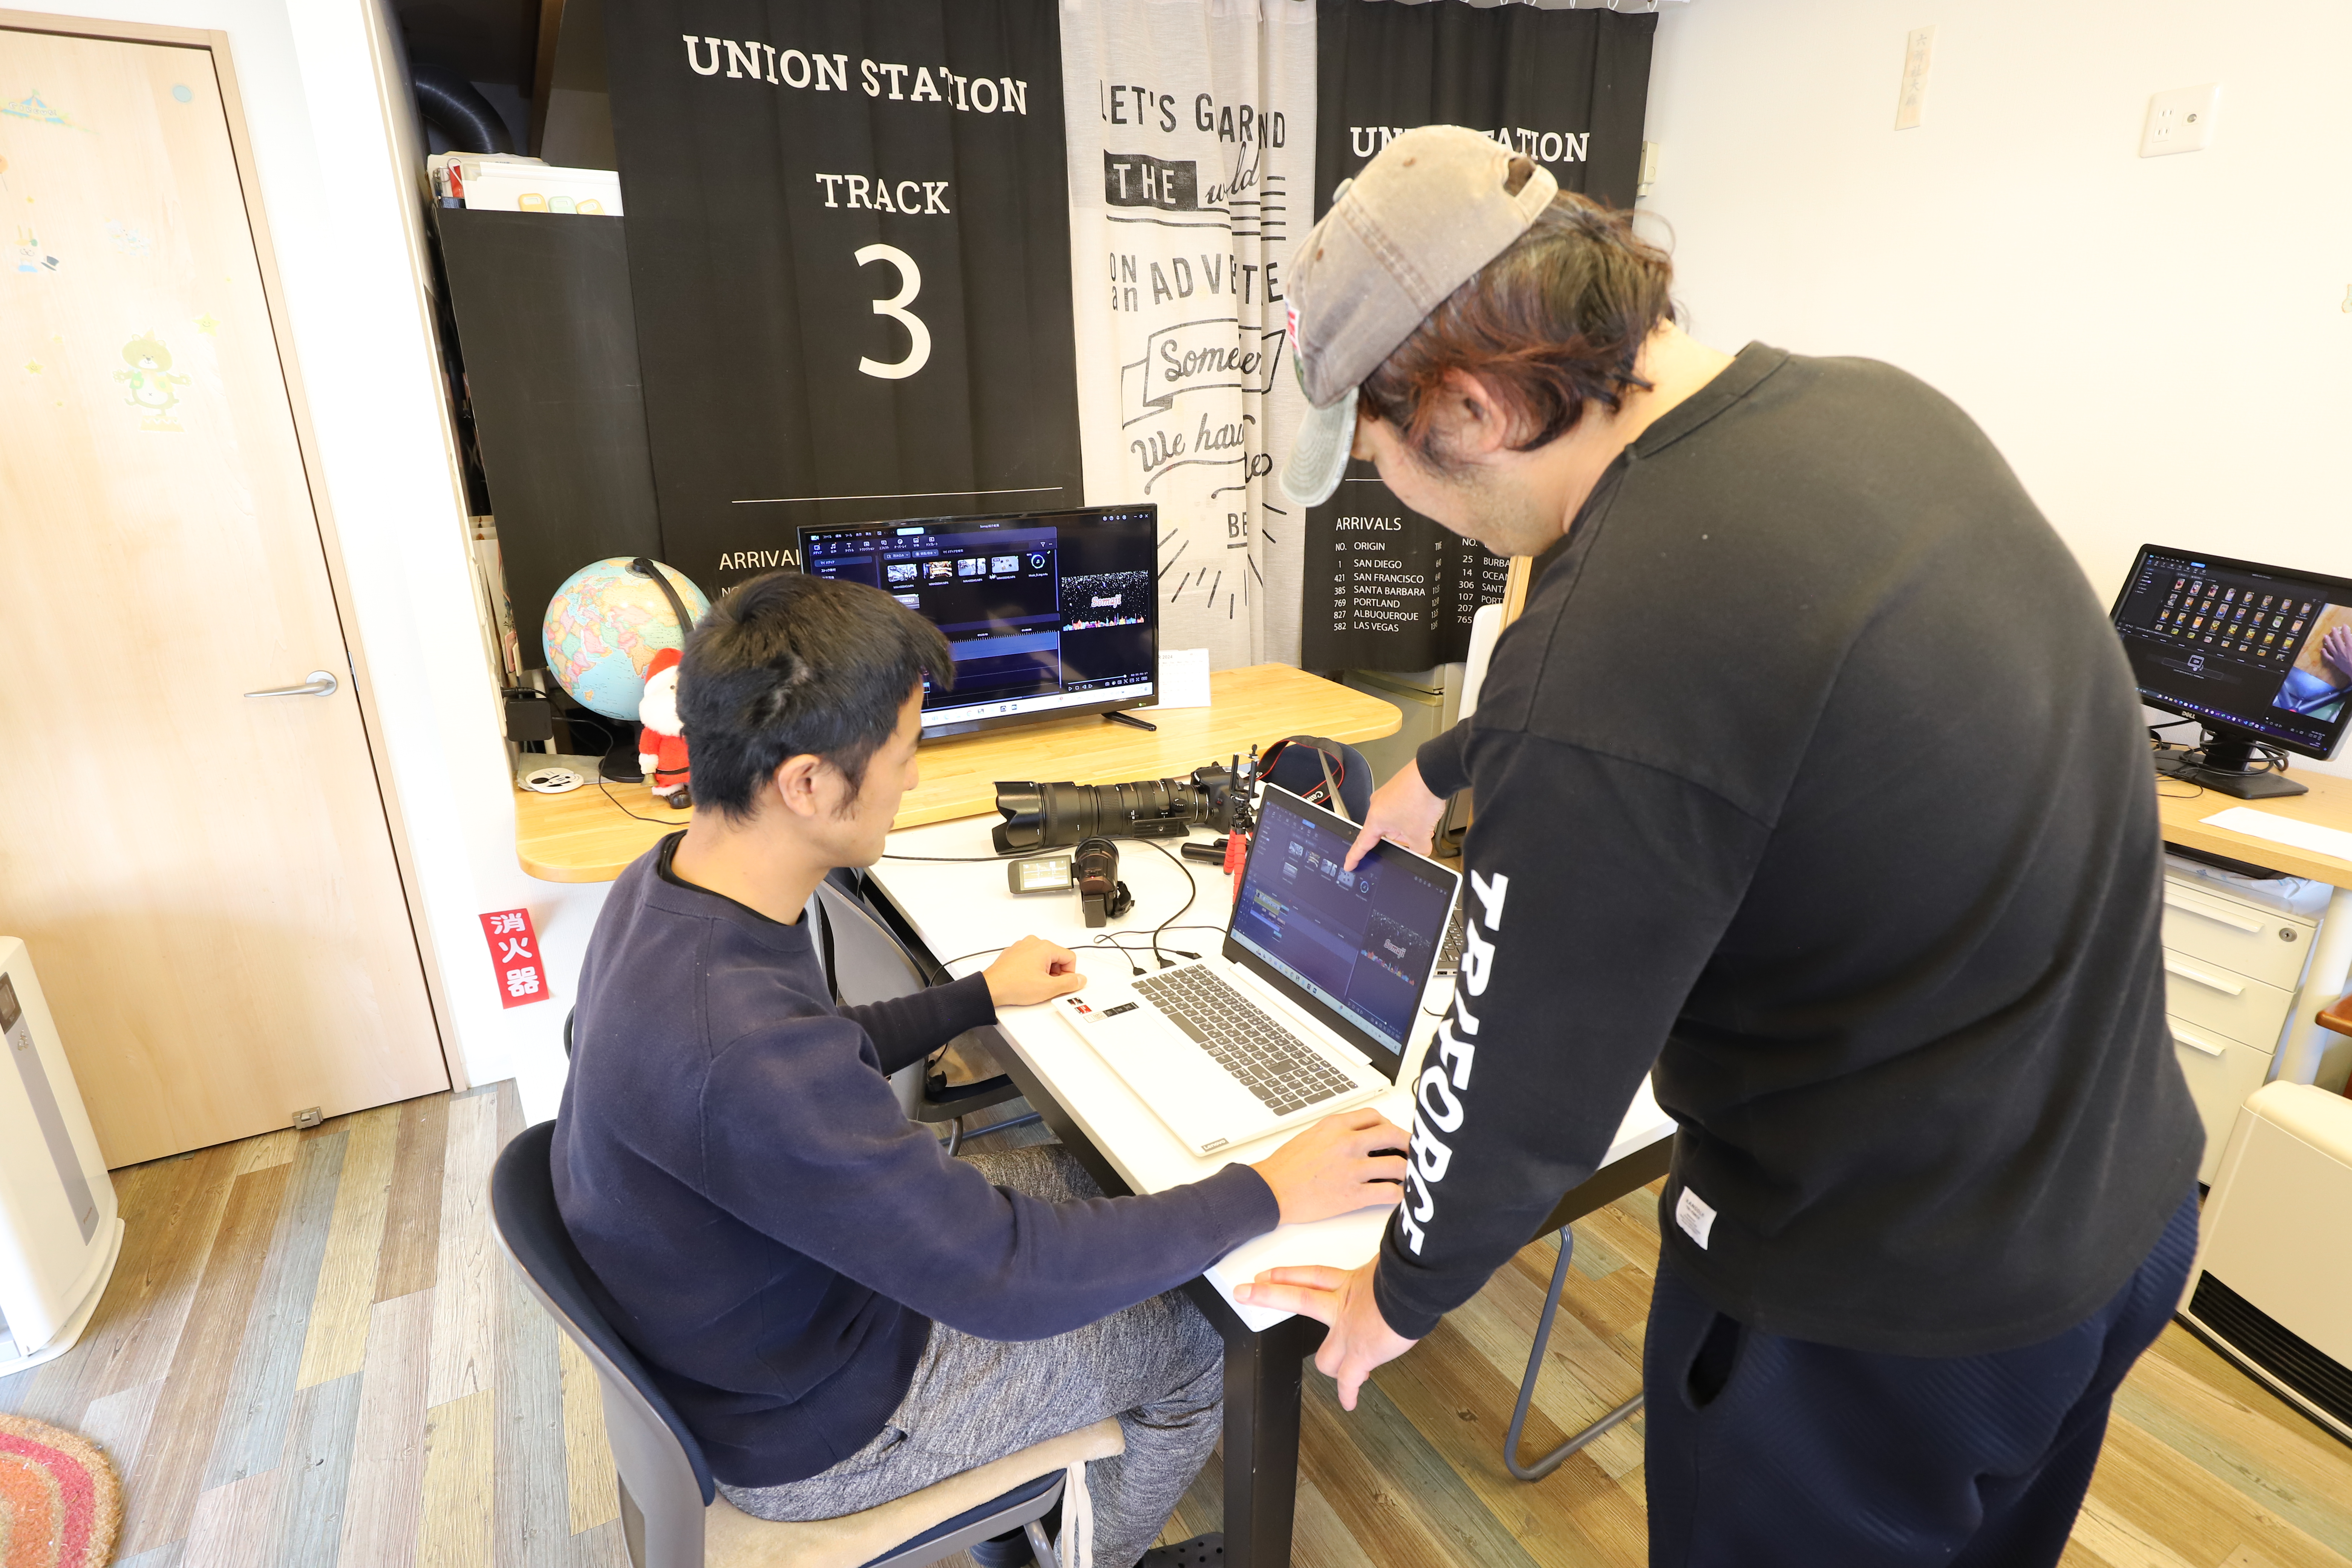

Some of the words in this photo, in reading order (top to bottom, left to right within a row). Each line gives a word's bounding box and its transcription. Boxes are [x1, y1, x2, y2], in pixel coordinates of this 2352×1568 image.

[683, 34, 848, 91] UNION
[861, 59, 1027, 115] STATION
[1113, 164, 1177, 204] THE
[816, 173, 950, 214] TRACK
[1110, 252, 1136, 283] ON
[1112, 286, 1138, 312] an
[854, 244, 931, 379] 3
[1130, 430, 1185, 472] We
[1336, 517, 1401, 531] ARRIVALS
[1335, 543, 1347, 551] NO.
[1354, 542, 1385, 550] ORIGIN
[1462, 538, 1478, 547] NO.
[1354, 559, 1372, 567] SAN
[1374, 560, 1402, 569] DIEGO
[1334, 574, 1345, 582] 421
[1354, 573, 1372, 581] SAN
[1374, 574, 1424, 583] FRANCISCO
[1334, 586, 1346, 595] 385
[1354, 585, 1383, 594] SANTA
[1385, 587, 1426, 596] BARBARA
[1091, 594, 1122, 608] Somaji
[1334, 599, 1346, 607] 769
[1354, 598, 1400, 608] PORTLAND
[1334, 610, 1346, 619] 827
[1354, 610, 1419, 621] ALBUQUERQUE
[1334, 622, 1346, 631] 582
[1354, 621, 1369, 629] LAS
[1371, 622, 1399, 632] VEGAS
[2182, 710, 2195, 719] DELL
[490, 913, 539, 997] 消火器
[1384, 939, 1406, 959] Somaji
[1203, 1140, 1225, 1150] Lenovo
